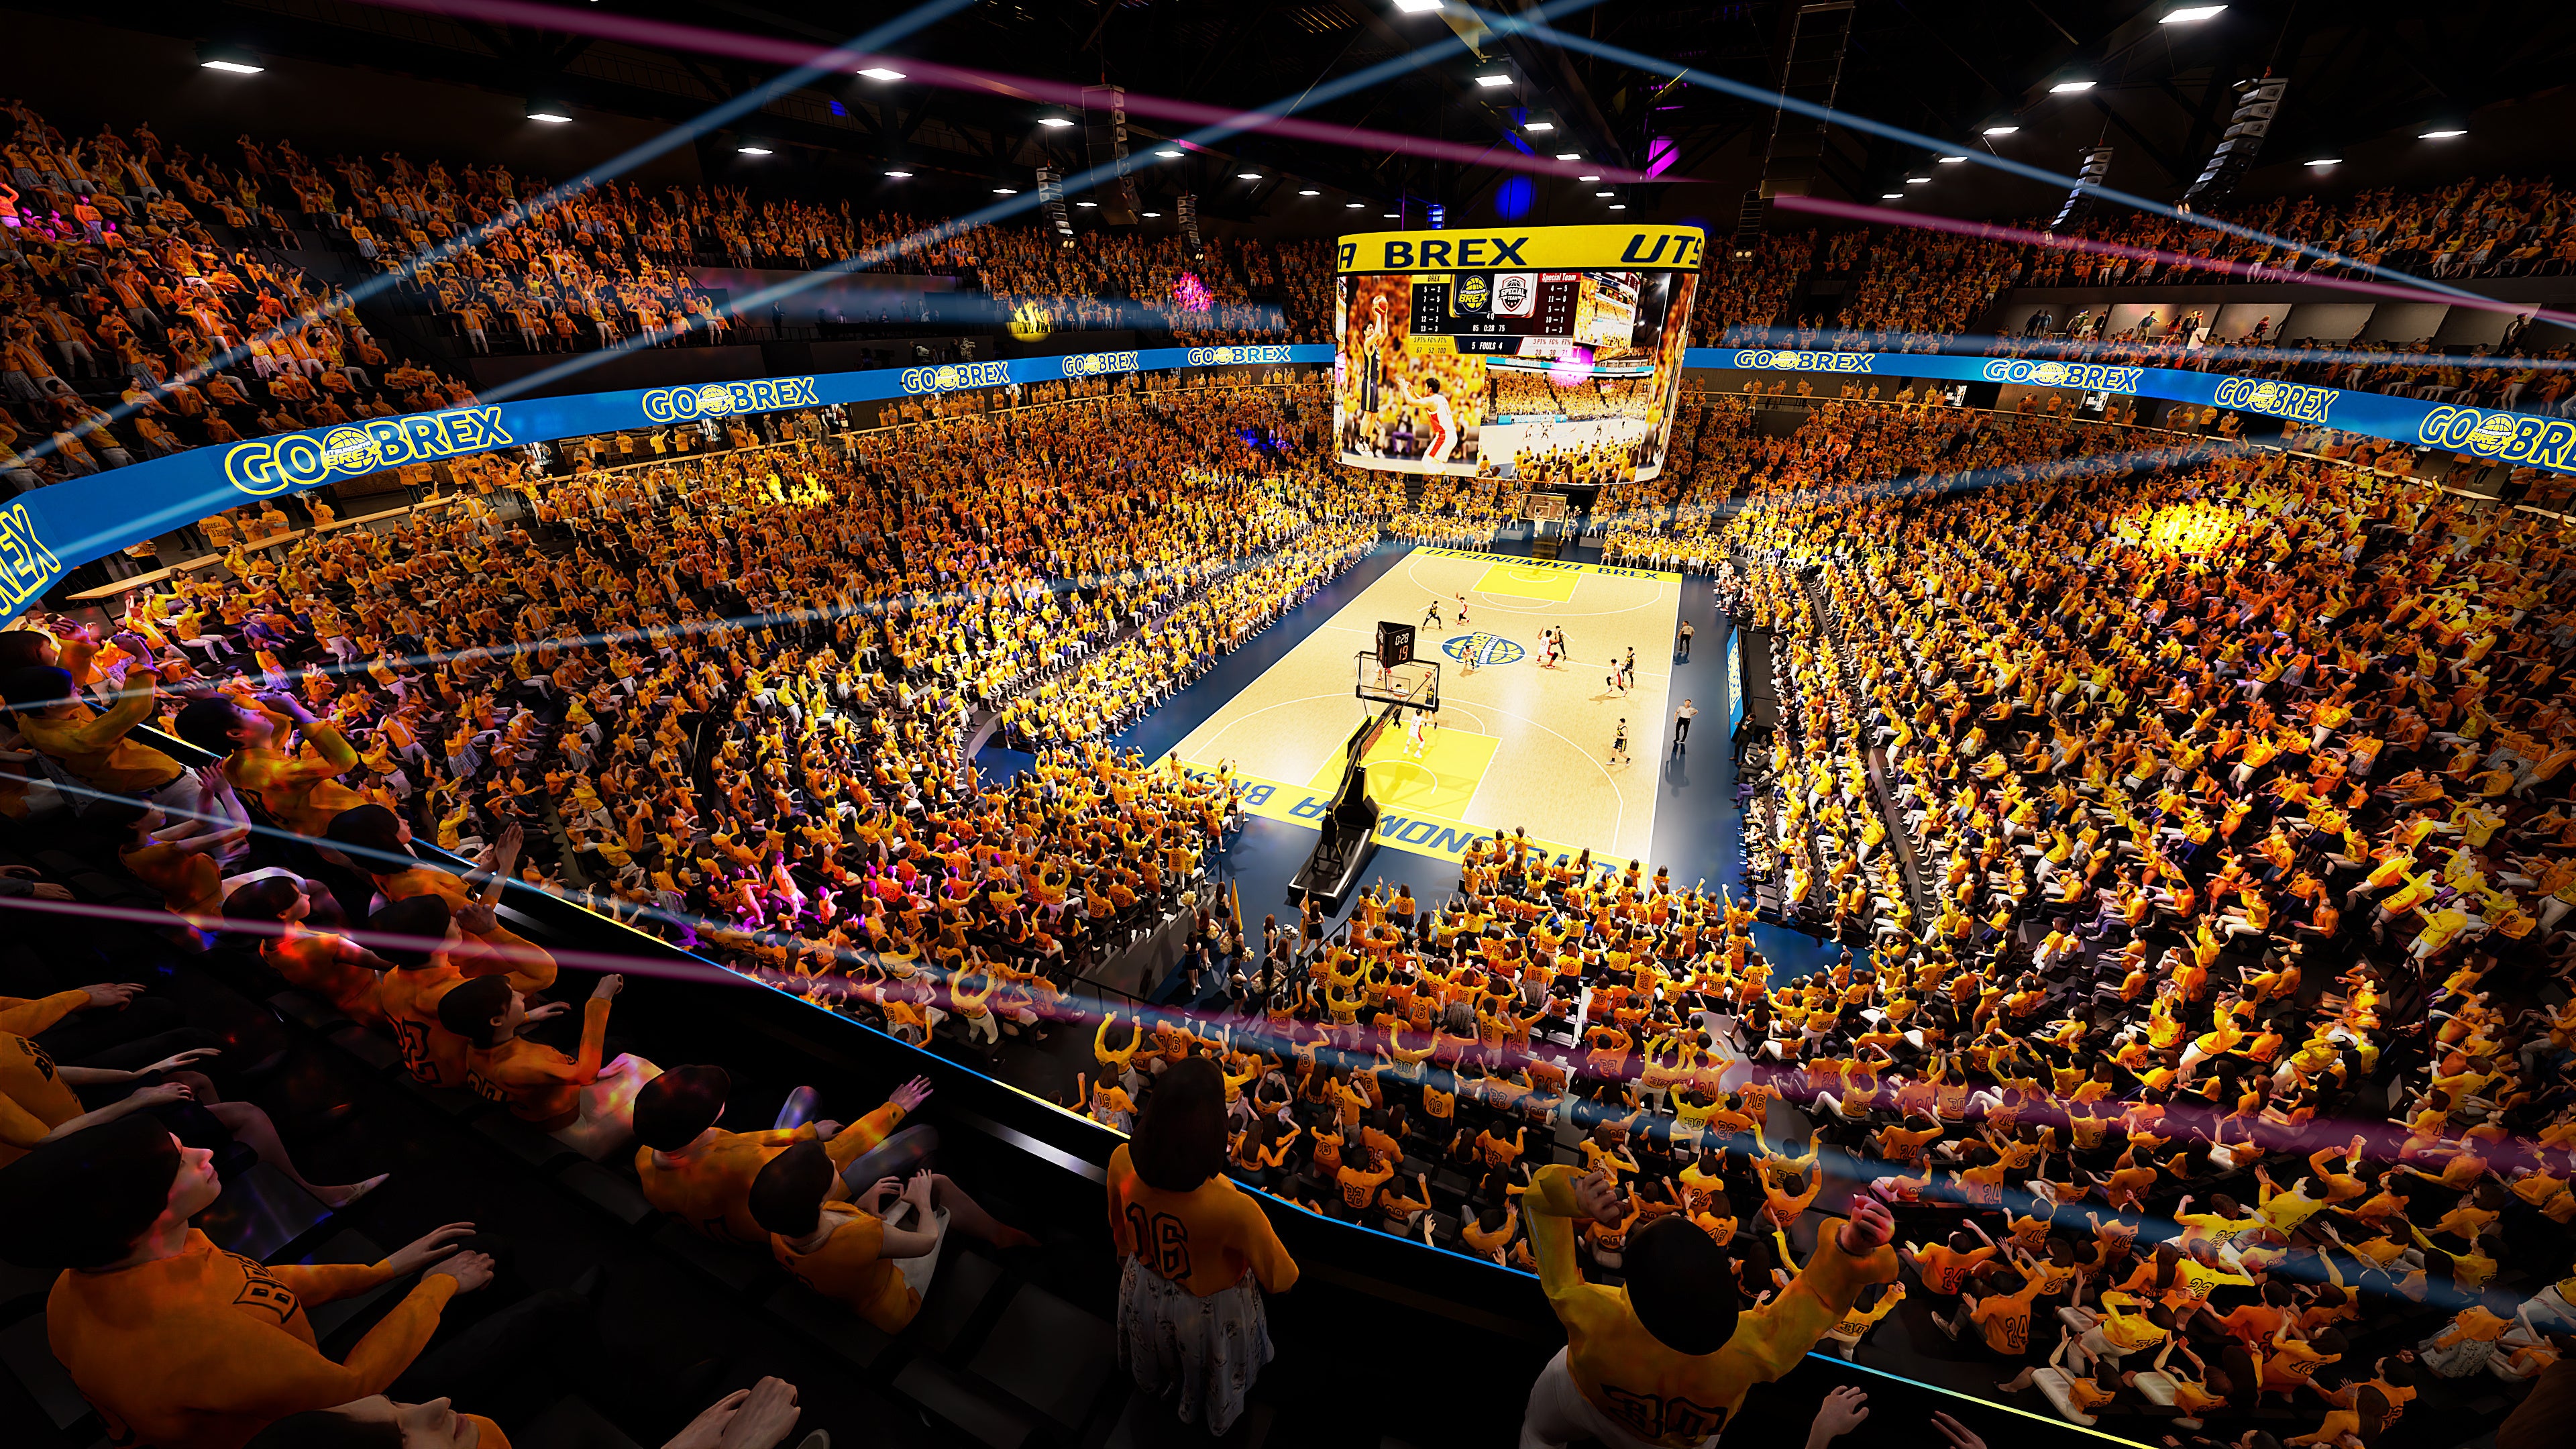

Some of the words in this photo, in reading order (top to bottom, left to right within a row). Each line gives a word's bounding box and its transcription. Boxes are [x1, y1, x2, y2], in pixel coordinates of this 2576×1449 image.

[1338, 243, 1357, 270] A
[1384, 237, 1529, 268] BREX
[1542, 273, 1562, 282] Special
[1562, 273, 1576, 281] Team
[1458, 292, 1489, 303] BREX
[1501, 288, 1525, 297] SPECIAL
[1471, 341, 1476, 350] 5
[1479, 341, 1497, 350] FOULS
[1499, 341, 1503, 350] 4
[1187, 347, 1215, 366] GO
[1230, 344, 1291, 363] BREX
[1734, 350, 1775, 368] GO
[1794, 351, 1875, 373] BREX
[1062, 355, 1085, 376] GO
[1098, 351, 1139, 374] BREX
[902, 367, 938, 394] GO
[955, 361, 1010, 388] BREX
[1983, 360, 2035, 382] GO
[2059, 364, 2144, 393] BREX
[642, 387, 698, 422] GO
[727, 377, 820, 413] BREX
[2214, 378, 2257, 408] GO
[2267, 384, 2340, 423] BREX
[2418, 405, 2481, 449] GO
[224, 435, 330, 495] GO
[367, 407, 514, 466] BREX
[325, 443, 381, 467] BREX
[1425, 549, 1584, 572] UTSUNOMIYA
[1597, 567, 1659, 580] BREX
[1395, 633, 1409, 646] 0:28
[1399, 645, 1409, 661] 19
[1621, 890, 1631, 901] 16
[1657, 900, 1668, 912] 16
[1684, 930, 1695, 942] 16
[1732, 941, 1743, 954] 16
[1564, 963, 1576, 975] 48
[1613, 957, 1625, 969] 48
[1531, 969, 1542, 981] 16
[1639, 975, 1650, 989] 22
[1752, 972, 1764, 985] 16
[1709, 981, 1723, 993] 30
[1456, 991, 1469, 1004] 16
[1593, 993, 1607, 1005] 16
[1413, 1005, 1426, 1020] 16
[1482, 1022, 1493, 1043] 22
[1817, 1020, 1833, 1030] 30
[1509, 1032, 1523, 1049] 24
[1395, 1059, 1412, 1074] 30
[1823, 1071, 1839, 1088] 24
[1491, 1088, 1509, 1107] 22
[1699, 1081, 1715, 1101] 24
[1428, 1099, 1443, 1115] 48
[1750, 1092, 1766, 1111] 16
[1854, 1101, 1870, 1112] 30
[1947, 1097, 1966, 1112] 30
[1717, 1119, 1737, 1138] 22
[1344, 1185, 1364, 1208] 22
[1984, 1182, 2003, 1205] 24
[1124, 1201, 1193, 1281] 16
[1707, 1228, 1729, 1244] 48
[1943, 1267, 1967, 1291] 24
[2189, 1277, 2215, 1302] 22
[2005, 1314, 2031, 1349] 24
